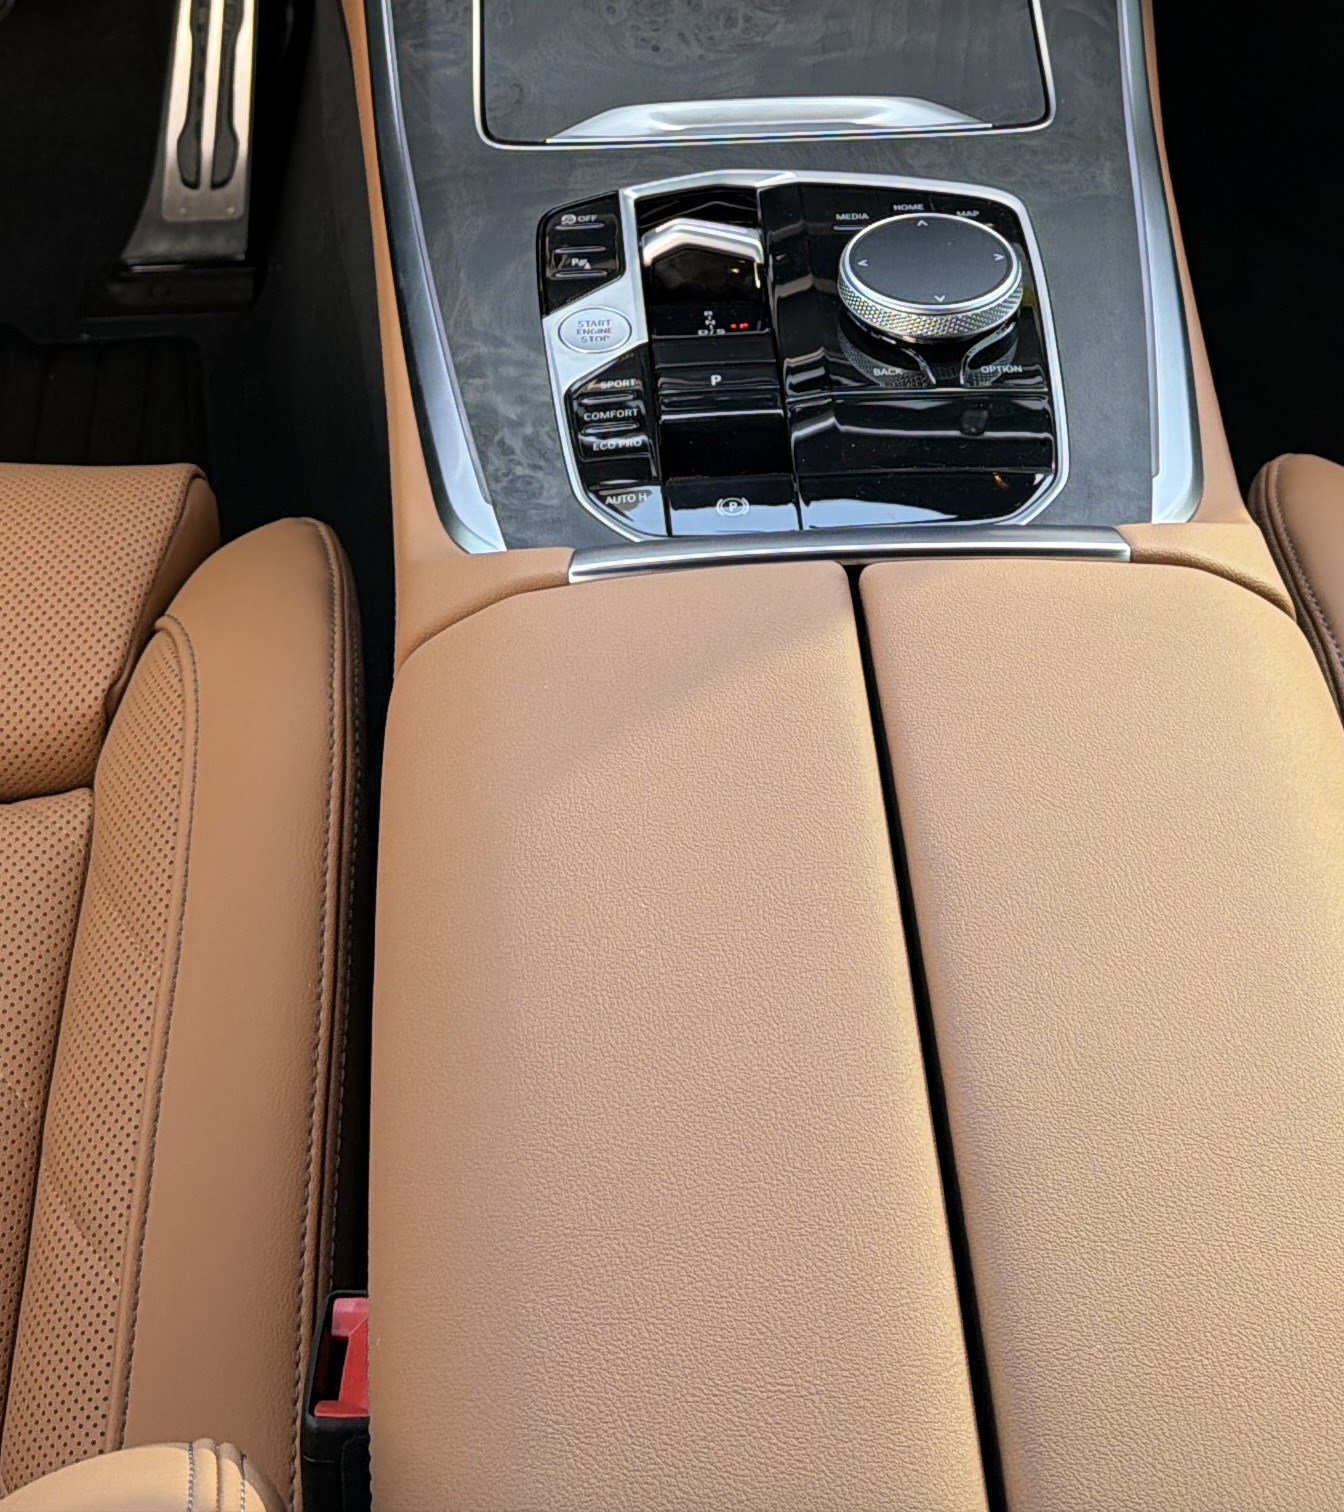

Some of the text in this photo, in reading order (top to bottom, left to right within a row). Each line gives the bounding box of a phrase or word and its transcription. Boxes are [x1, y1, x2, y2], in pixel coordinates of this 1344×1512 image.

[893, 203, 925, 211] HOME
[578, 214, 598, 223] OFF
[835, 212, 870, 221] MEDIA
[956, 210, 980, 218] MAP
[577, 319, 612, 328] START
[576, 327, 613, 335] ENGINE
[580, 335, 610, 343] STOP
[873, 367, 904, 377] BACK
[980, 365, 1023, 373] OPTION
[600, 378, 636, 389] SPORT
[711, 374, 722, 386] P
[583, 408, 639, 421] COMFORT
[593, 440, 642, 451] ECO PRO
[605, 492, 648, 505] AUTO H
